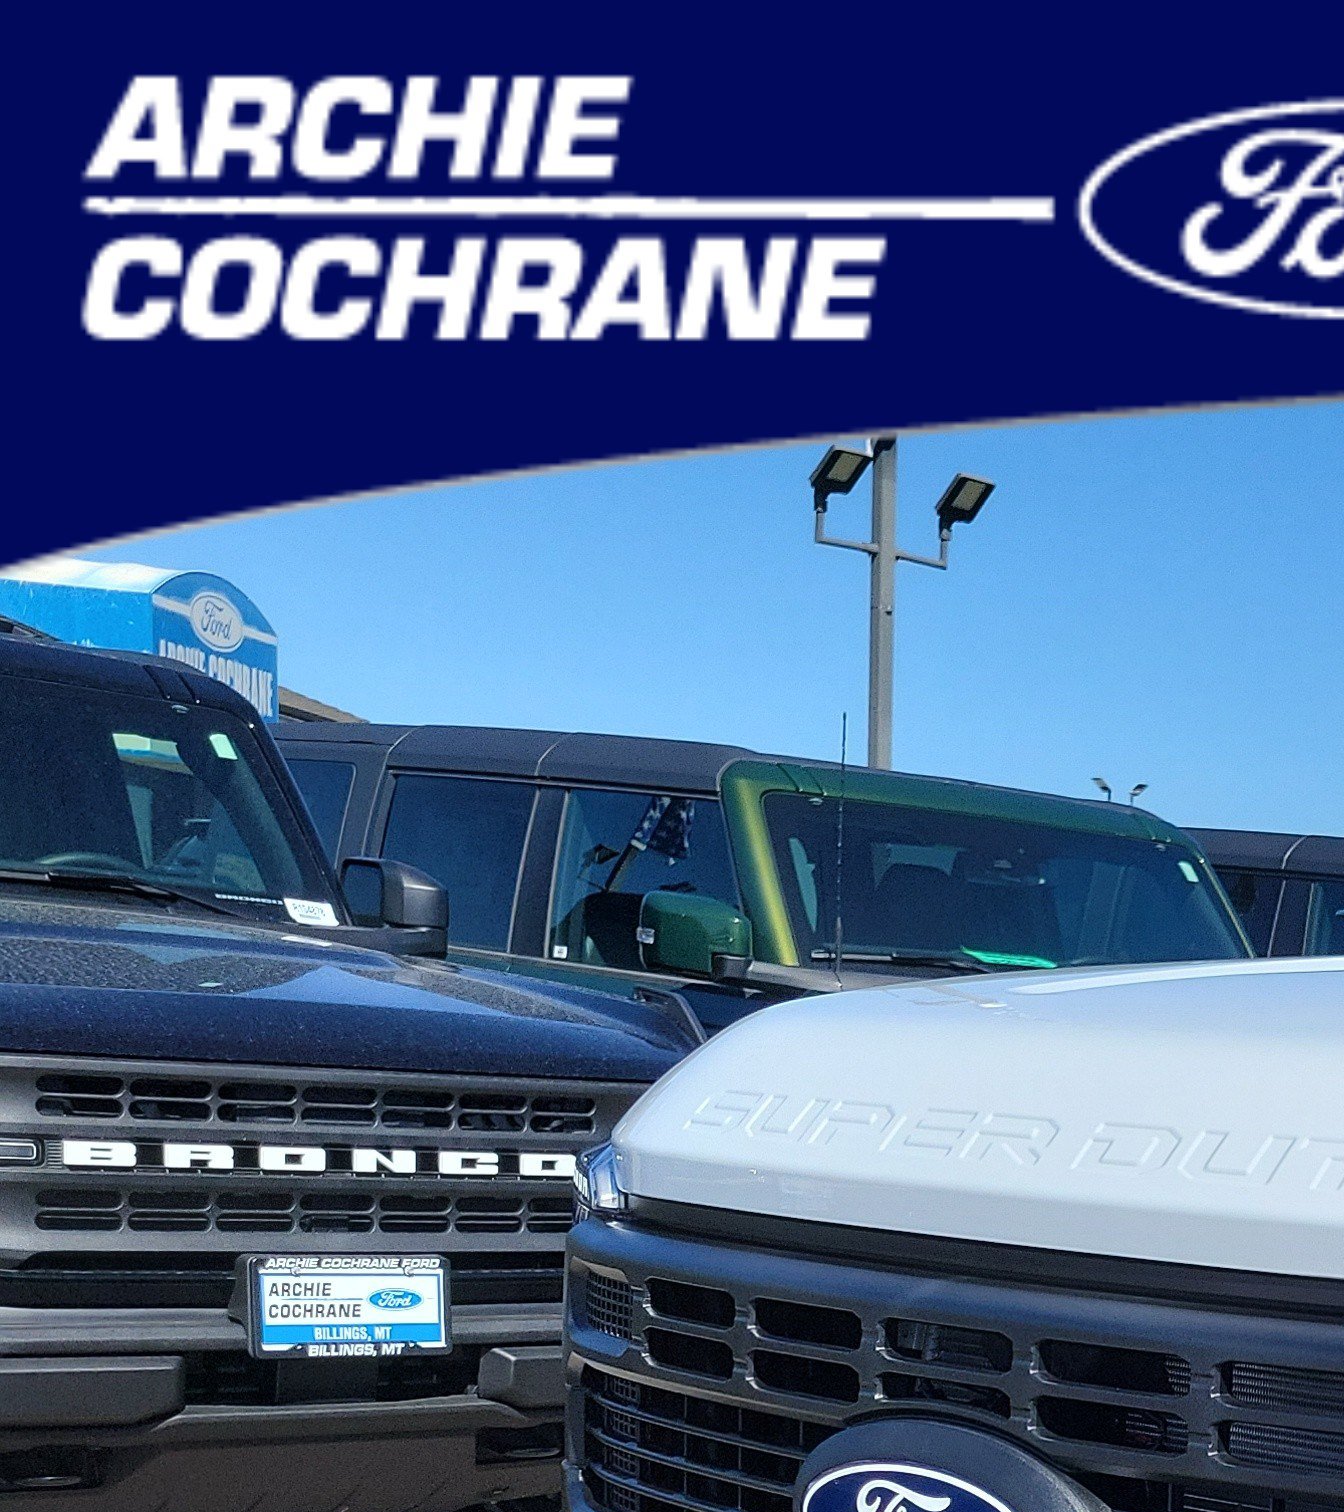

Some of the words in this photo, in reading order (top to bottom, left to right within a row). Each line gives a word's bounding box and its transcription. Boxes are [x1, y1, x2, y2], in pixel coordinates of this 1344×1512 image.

[201, 600, 232, 640] Ford
[682, 1089, 1061, 1164] SUPER
[61, 1139, 578, 1176] BRONCO
[265, 1257, 319, 1269] ARCHIE
[321, 1258, 400, 1269] COCHRANE
[401, 1259, 441, 1270] FORD
[269, 1282, 332, 1297] ARCHIE
[376, 1290, 413, 1309] Ford
[268, 1303, 362, 1319] COCHRANE
[314, 1326, 372, 1341] BILLINGS,
[374, 1326, 393, 1340] MT
[308, 1343, 378, 1357] BILLINGS,
[381, 1343, 406, 1355] MT
